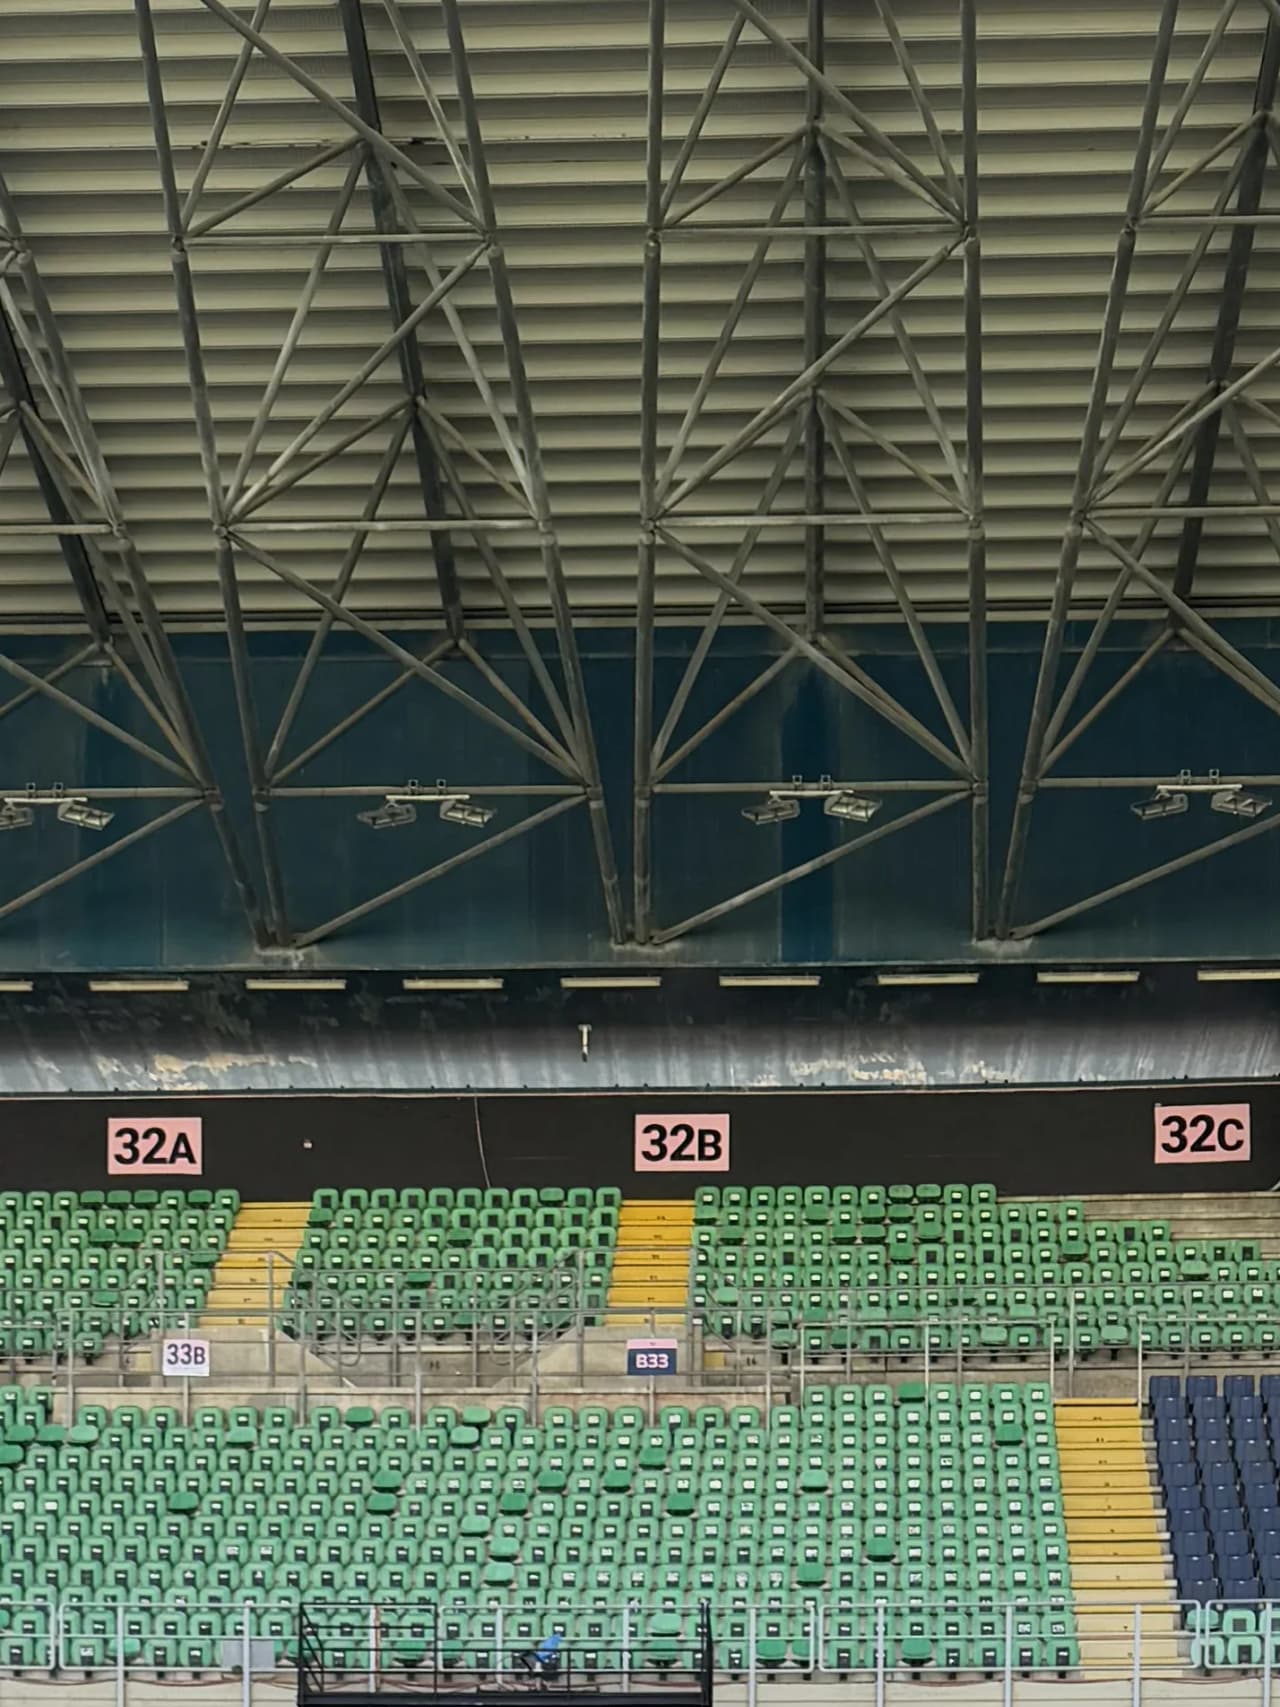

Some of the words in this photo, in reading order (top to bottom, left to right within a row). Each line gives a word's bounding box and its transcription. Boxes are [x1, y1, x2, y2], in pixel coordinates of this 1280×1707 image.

[113, 1127, 197, 1165] 32A
[641, 1123, 722, 1162] 32B
[1161, 1114, 1244, 1153] 32C
[166, 1343, 206, 1365] 33B
[635, 1353, 669, 1369] B33
